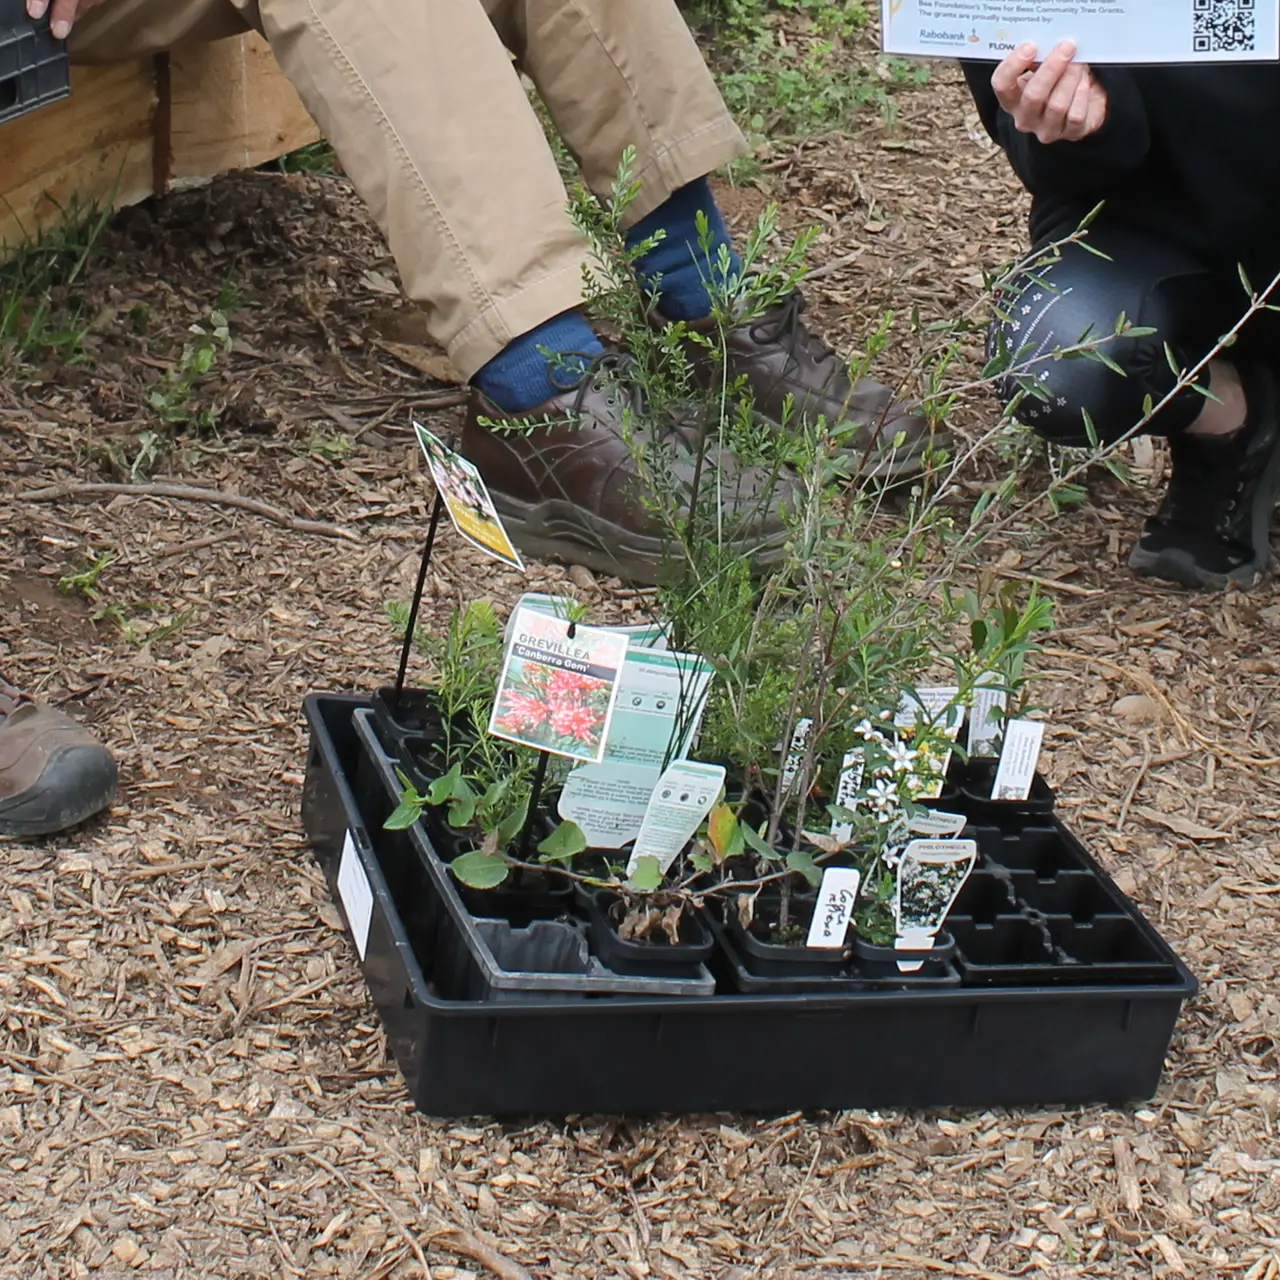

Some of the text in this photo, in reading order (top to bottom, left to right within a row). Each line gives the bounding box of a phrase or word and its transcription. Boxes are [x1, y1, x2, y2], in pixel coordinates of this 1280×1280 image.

[918, 0, 933, 7] Bee
[934, 0, 980, 11] Foundation's
[982, 3, 1001, 12] Trees
[1016, 5, 1034, 13] Bees
[1035, 5, 1079, 15] Community
[1080, 6, 1097, 14] Tree
[918, 8, 932, 17] The
[933, 11, 957, 19] grants
[972, 13, 1000, 22] proudly
[1001, 15, 1040, 24] supported
[920, 29, 965, 40] Rabobank
[988, 41, 1017, 51] FLOW
[519, 633, 590, 661] GREVILLEA
[516, 645, 562, 666] 'Canberra
[918, 843, 968, 851] PHILOTHECA
